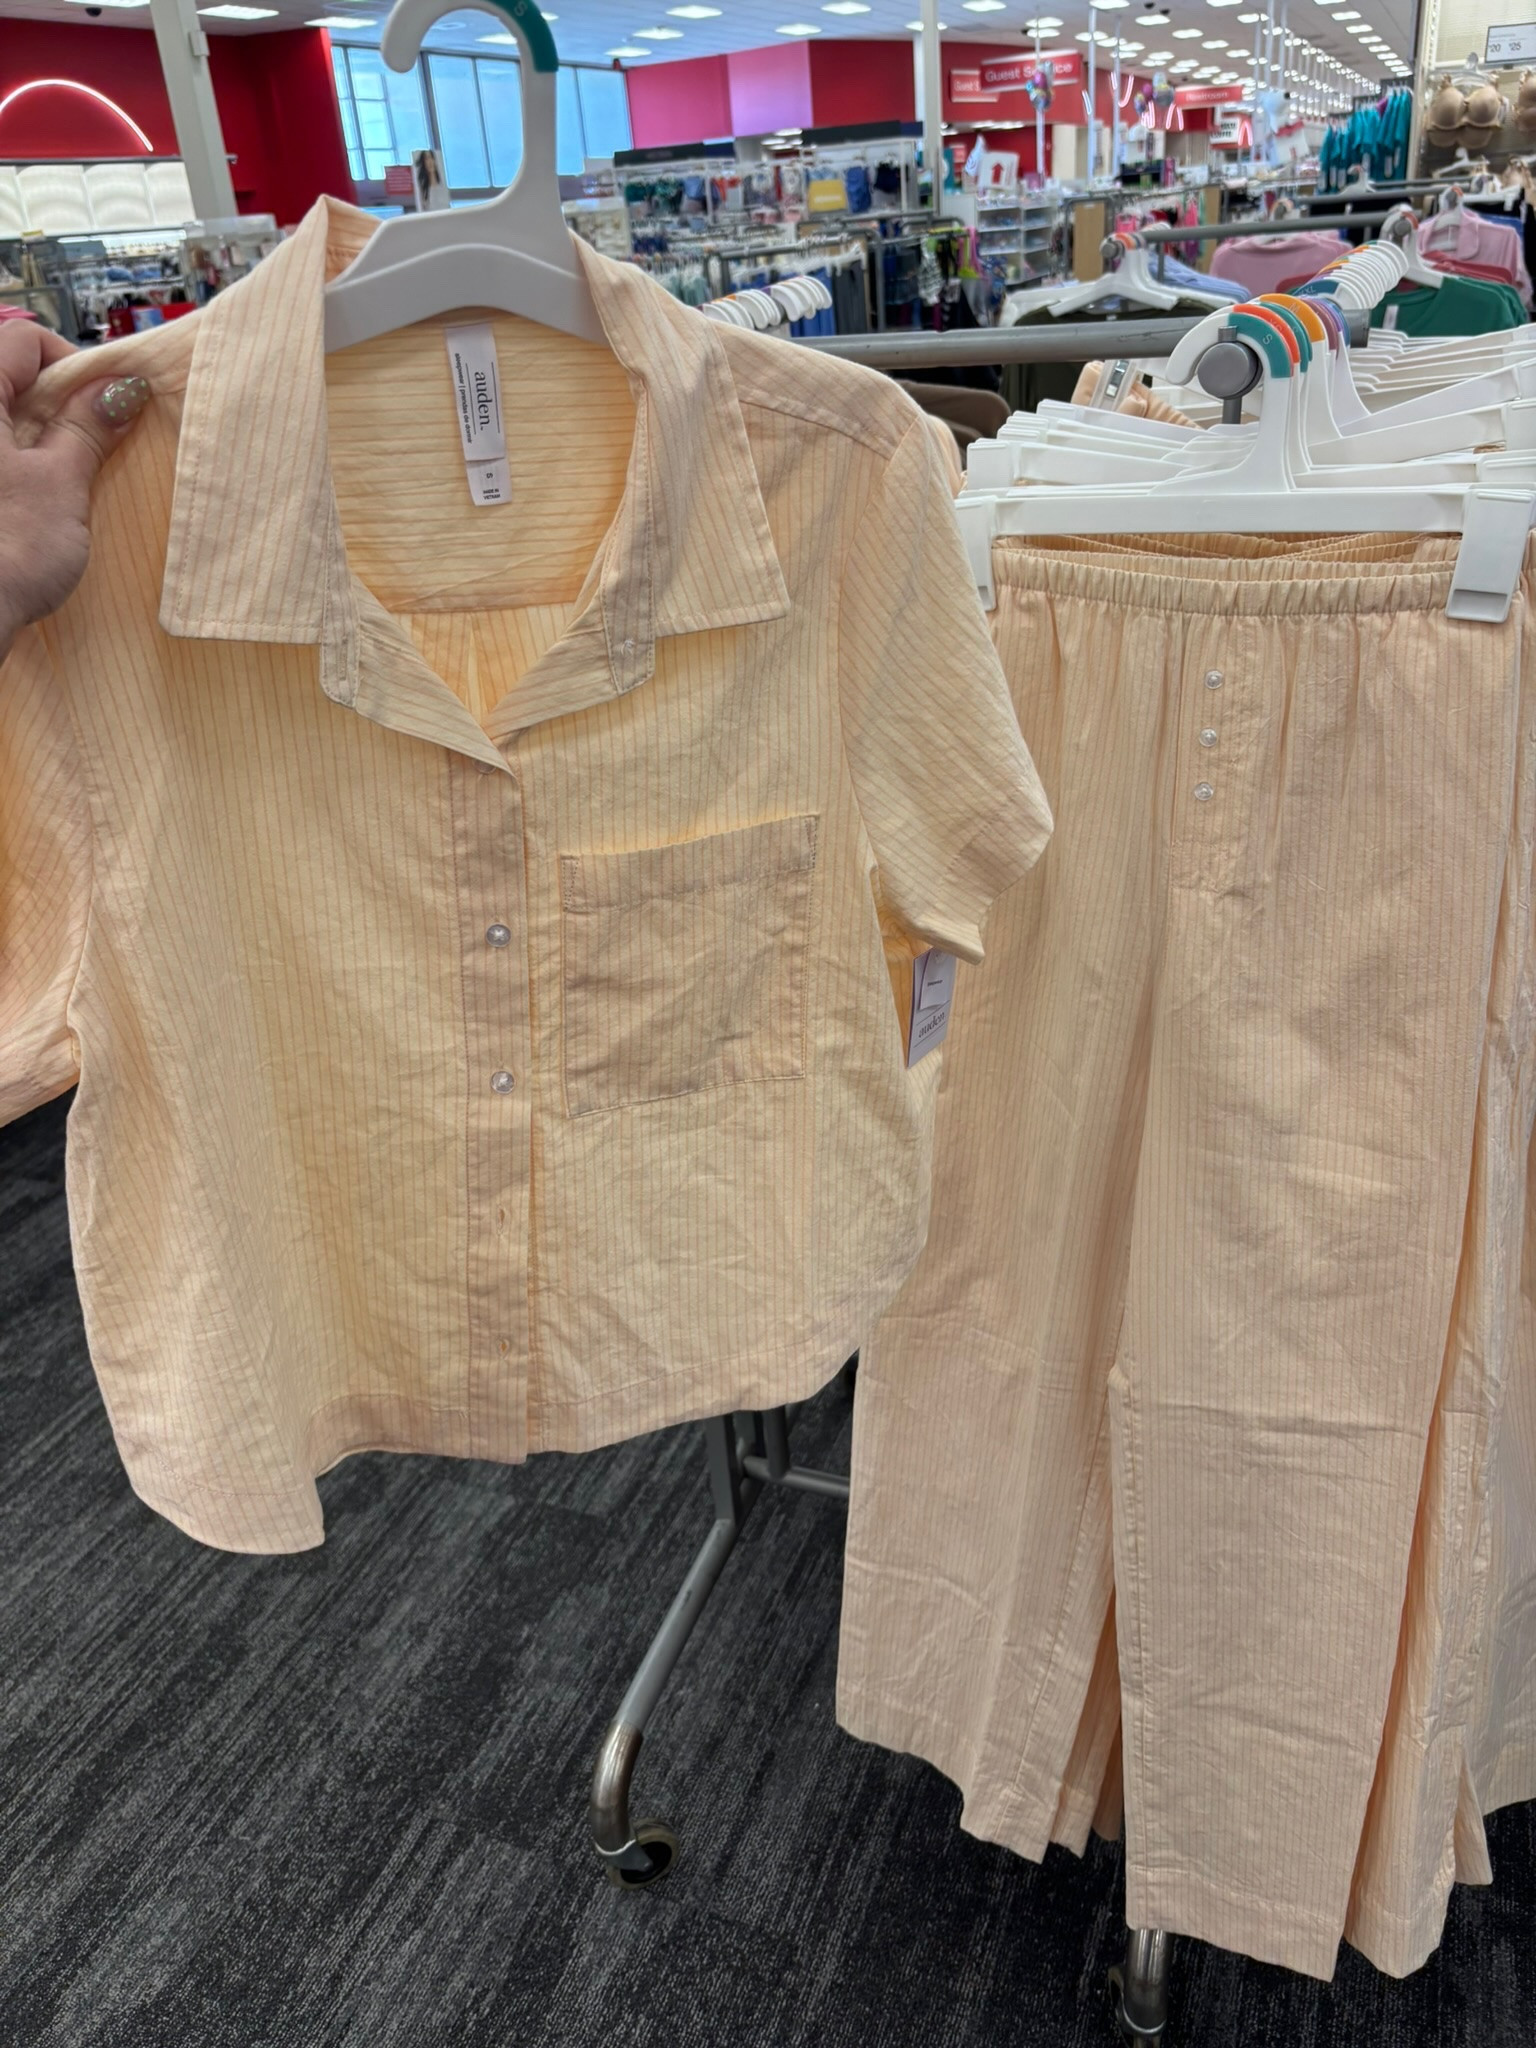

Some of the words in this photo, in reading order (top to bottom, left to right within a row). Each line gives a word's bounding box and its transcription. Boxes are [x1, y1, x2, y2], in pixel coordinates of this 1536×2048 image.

[514, 1, 528, 17] S
[985, 69, 1020, 82] Guest
[1023, 62, 1073, 78] Seice
[1262, 333, 1273, 345] S
[474, 371, 493, 425] auden
